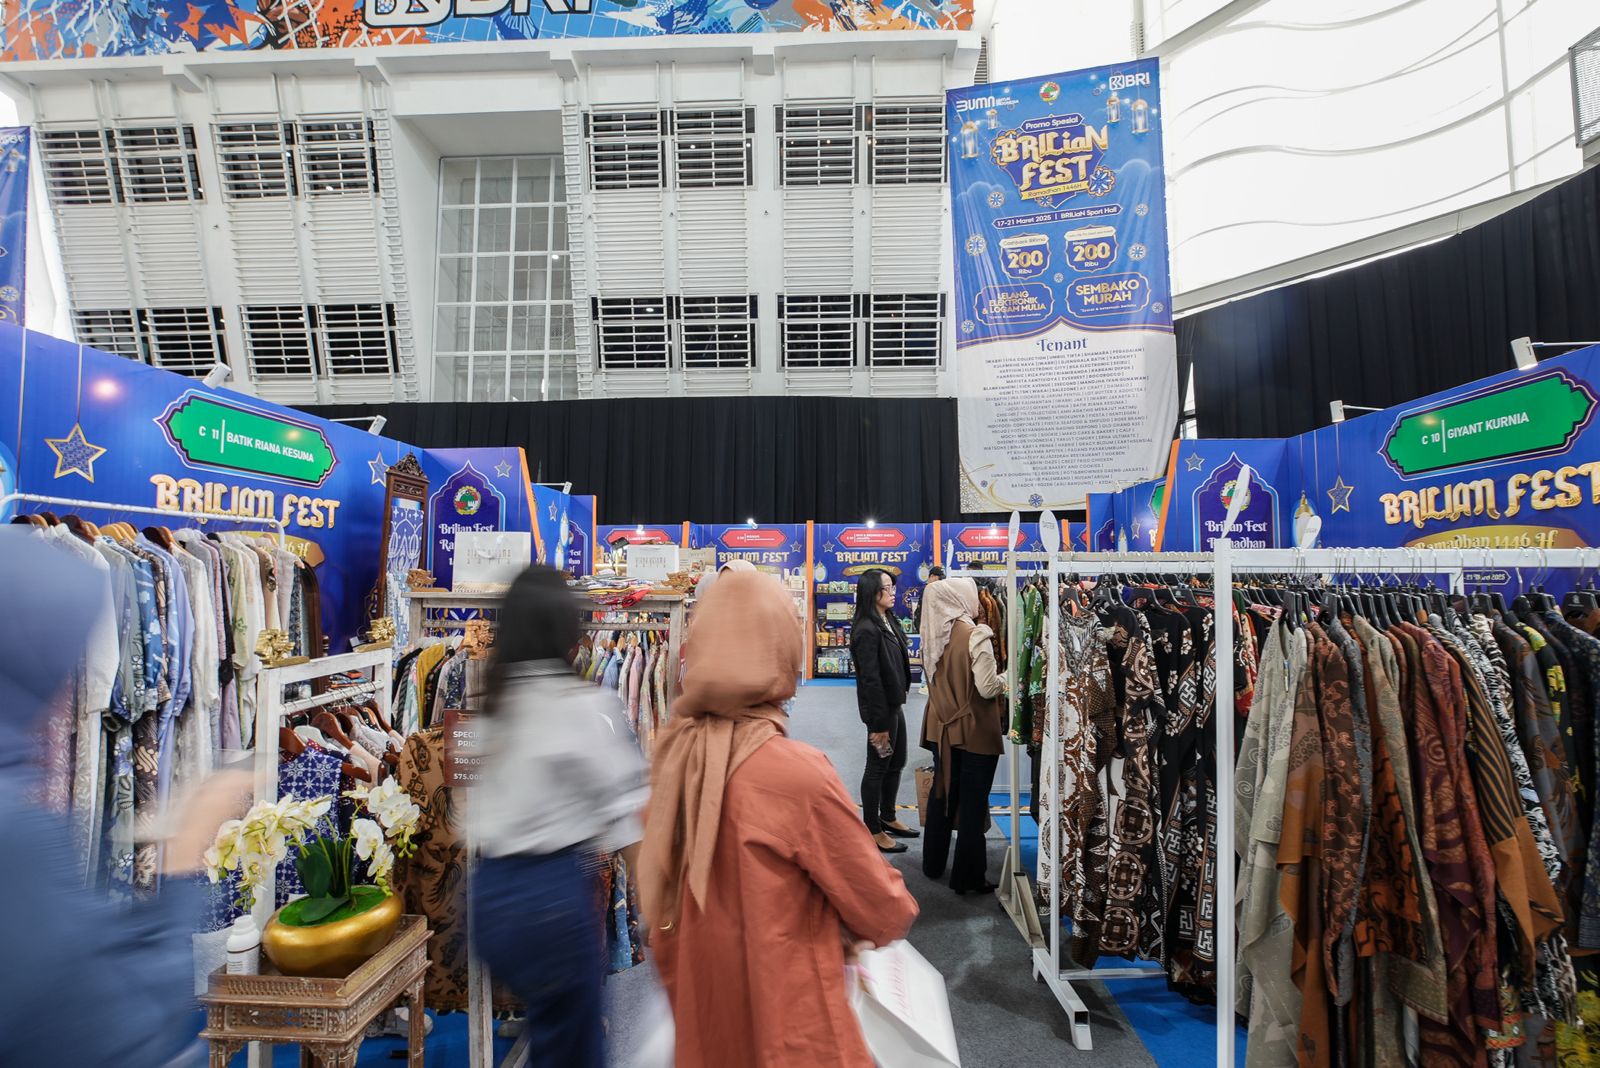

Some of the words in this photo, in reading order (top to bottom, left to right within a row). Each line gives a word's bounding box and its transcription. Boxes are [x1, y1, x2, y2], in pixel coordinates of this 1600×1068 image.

[1124, 72, 1150, 88] BRI
[1026, 120, 1050, 130] Promo
[1052, 116, 1078, 126] Spesial
[1020, 154, 1093, 191] FEST
[1028, 186, 1061, 197] Ramadhan
[1087, 208, 1103, 217] Sport
[1073, 242, 1110, 262] 200
[1008, 250, 1044, 269] 200
[1075, 279, 1139, 296] SEMBAKO
[989, 297, 1038, 307] ELEKTRONIK
[997, 290, 1029, 300] LELANG
[1083, 291, 1131, 306] MURAH
[990, 305, 1021, 314] LOGAM
[1022, 304, 1046, 312] MULIA
[1036, 338, 1087, 352] Tenant
[1421, 435, 1428, 444] C
[1431, 432, 1440, 443] 10
[1447, 422, 1483, 440] GIYANT
[1485, 411, 1530, 431] KURNIA
[198, 426, 206, 436] C
[212, 429, 219, 440] 11
[226, 432, 253, 447] BATIK
[255, 440, 280, 455] RIANA
[282, 447, 314, 463] KESUMA
[280, 493, 340, 529] FEST
[1244, 520, 1267, 532] Fest
[1494, 532, 1529, 548] 1446
[762, 552, 790, 563] FEST
[880, 551, 909, 563] FEST
